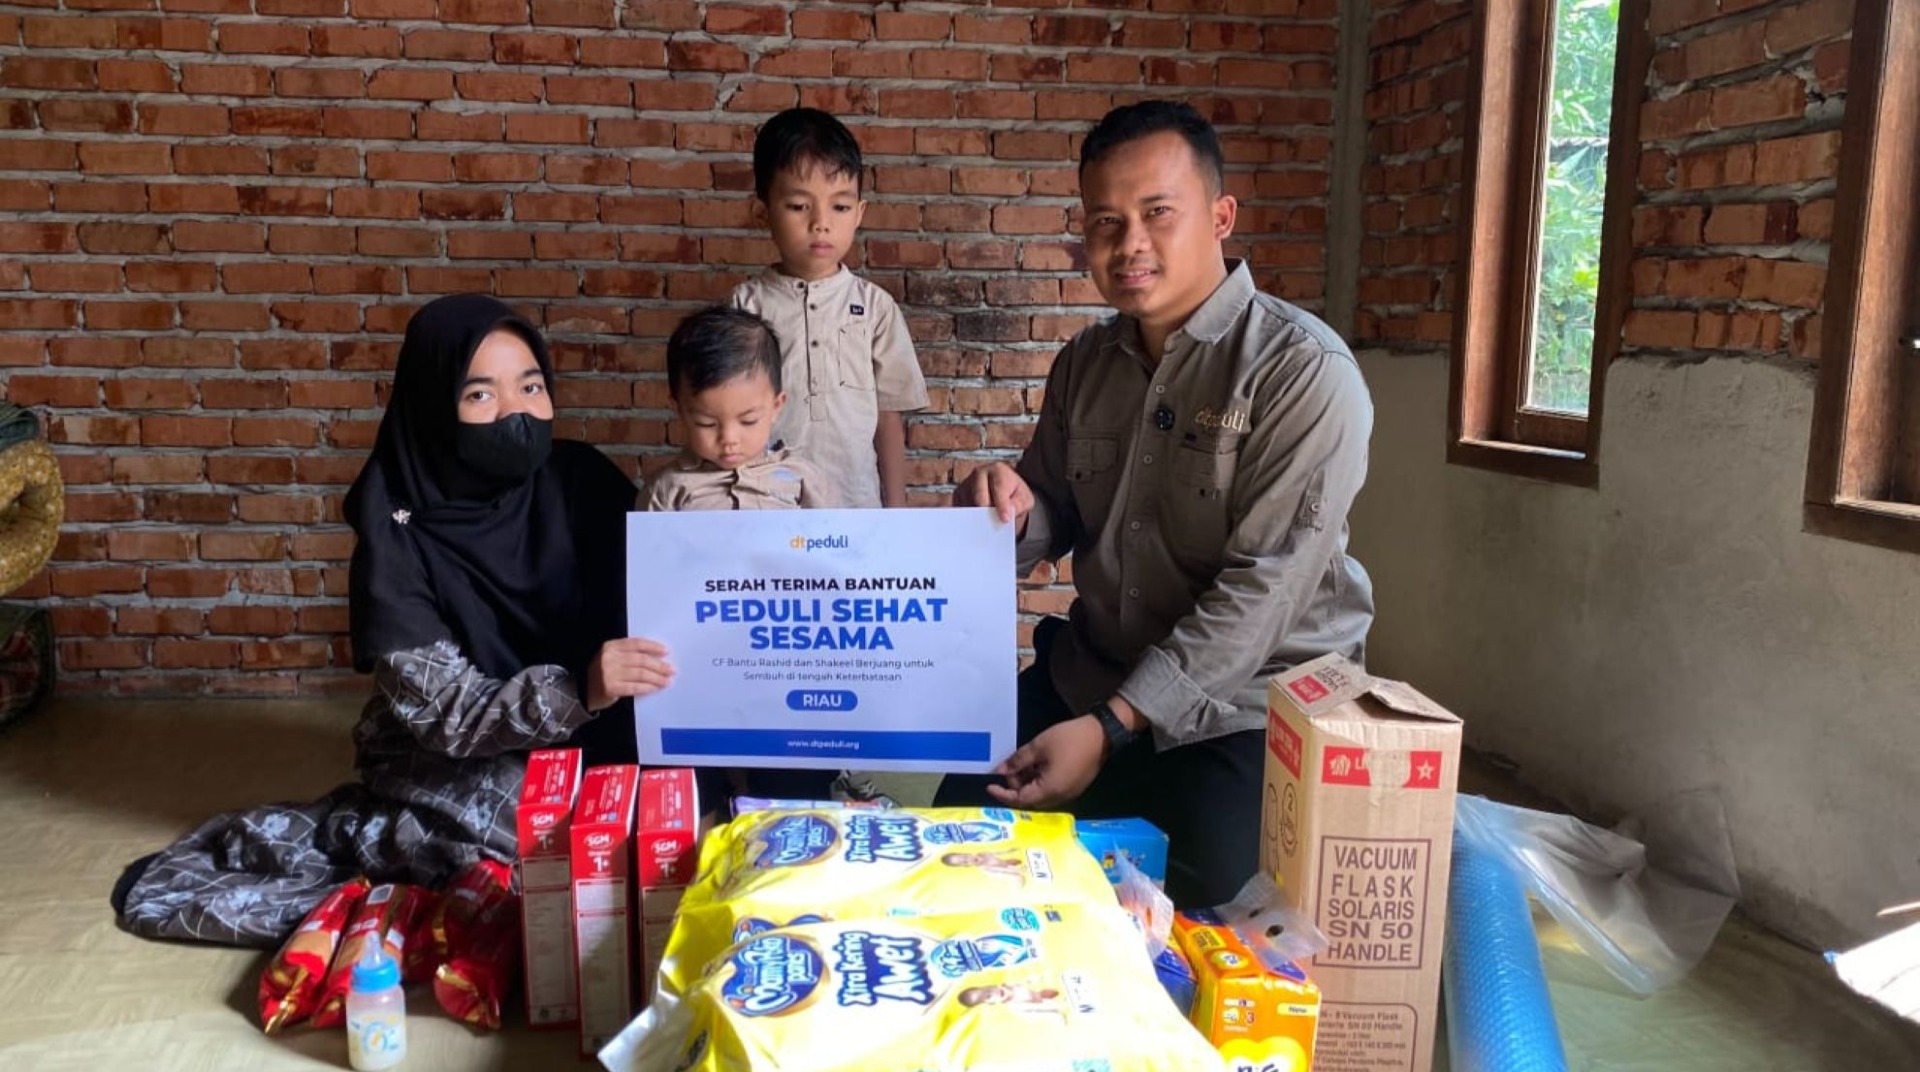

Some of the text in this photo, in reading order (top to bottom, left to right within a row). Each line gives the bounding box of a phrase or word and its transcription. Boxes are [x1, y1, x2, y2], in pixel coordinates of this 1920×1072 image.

[705, 576, 936, 593] SERAH TERIMA BANTUAN
[695, 598, 948, 623] PEDULI SEHAT
[749, 625, 894, 650] SESAMA
[712, 658, 934, 670] CF Bantu Rashid dan Shakeel Berjuang untuk
[743, 671, 902, 683] Sembuh di tengah Keterbatasan
[803, 693, 842, 708] RIAU
[787, 739, 860, 751] www.dtpeduli.org
[532, 813, 555, 827] SGM
[587, 834, 610, 847] SGM
[653, 840, 678, 854] SGM
[874, 819, 918, 859] Awet
[849, 840, 873, 861] Xtra
[1333, 845, 1418, 870] VACUUM
[1331, 874, 1414, 898] FLASK
[1327, 899, 1415, 920] SOLARIS
[1327, 920, 1414, 940] SN 50
[1327, 942, 1413, 962] HANDLE
[837, 932, 873, 1004] Xtra Kering
[870, 936, 927, 1002] Awet
